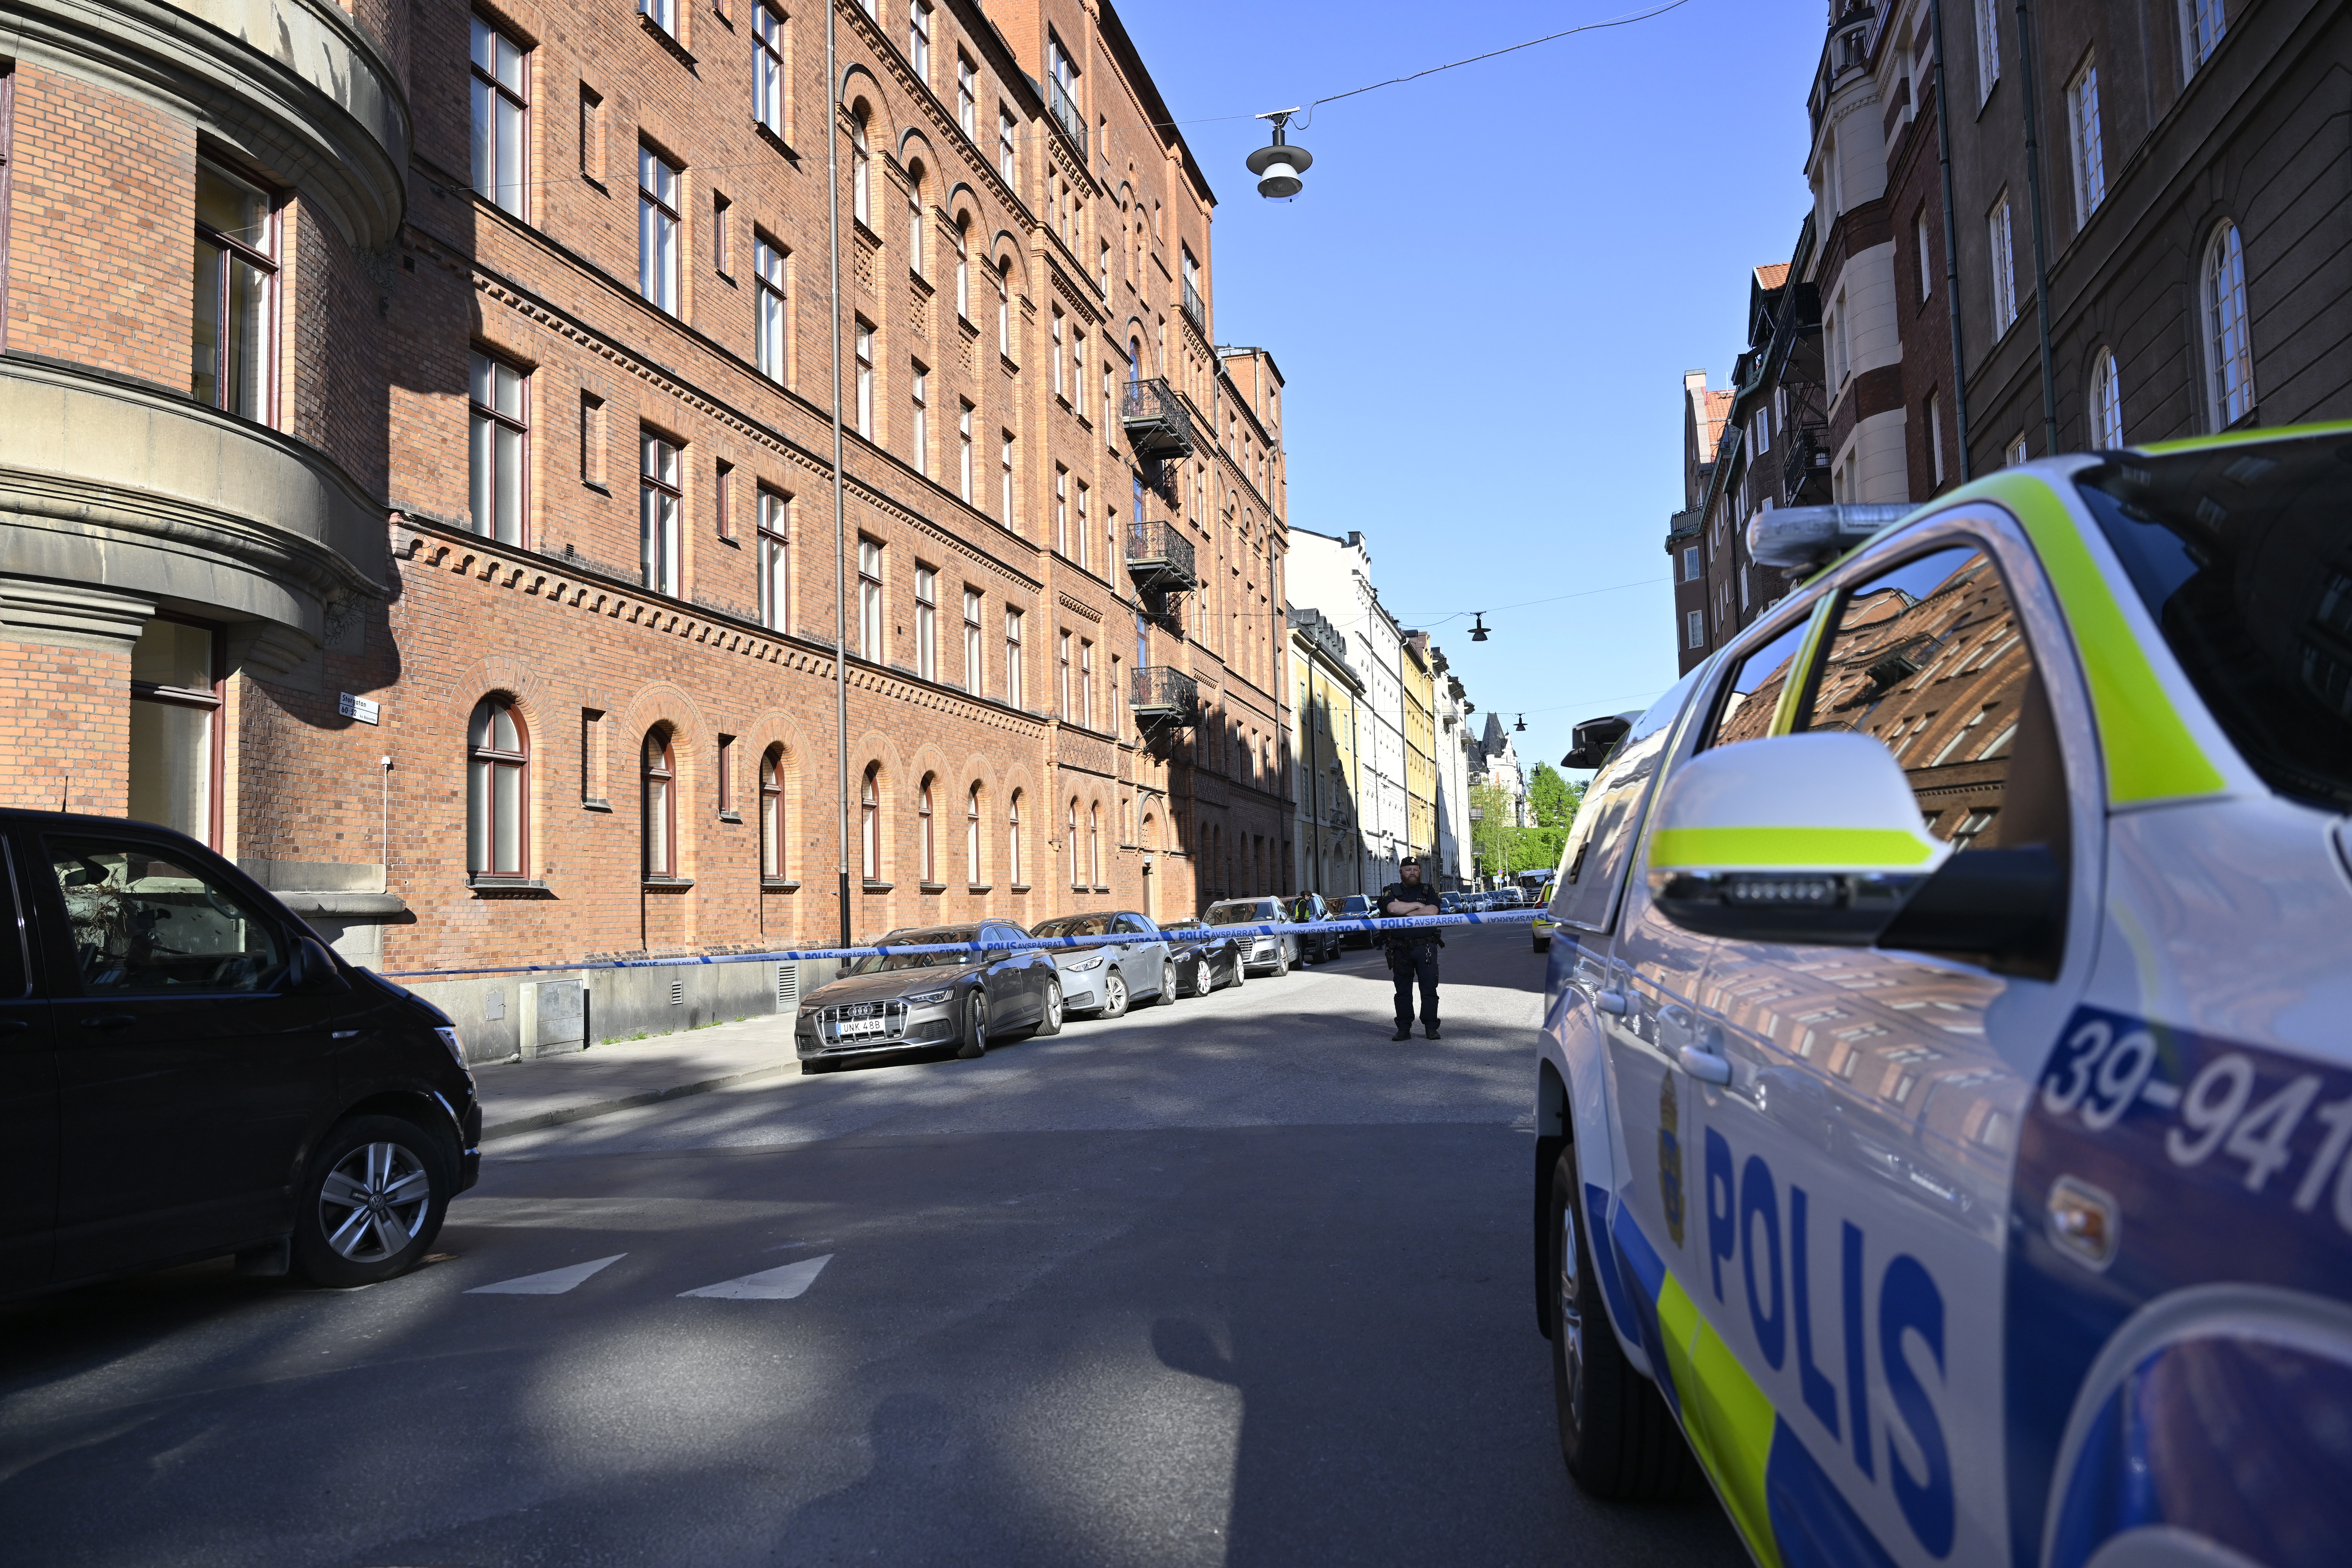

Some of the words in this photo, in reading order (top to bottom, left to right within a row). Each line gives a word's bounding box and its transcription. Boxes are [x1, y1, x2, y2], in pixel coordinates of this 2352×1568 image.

[342, 695, 366, 707] Storgatan
[341, 706, 357, 716] 60-52
[1381, 918, 1413, 929] POLIS
[1415, 916, 1463, 926] AVSPÄRRAT
[1179, 931, 1209, 940] POLIS
[1211, 929, 1257, 938] AVSPÄRRAT
[844, 1023, 860, 1032] UNK
[863, 1021, 880, 1030] 48B
[1705, 1125, 1956, 1561] POLIS
